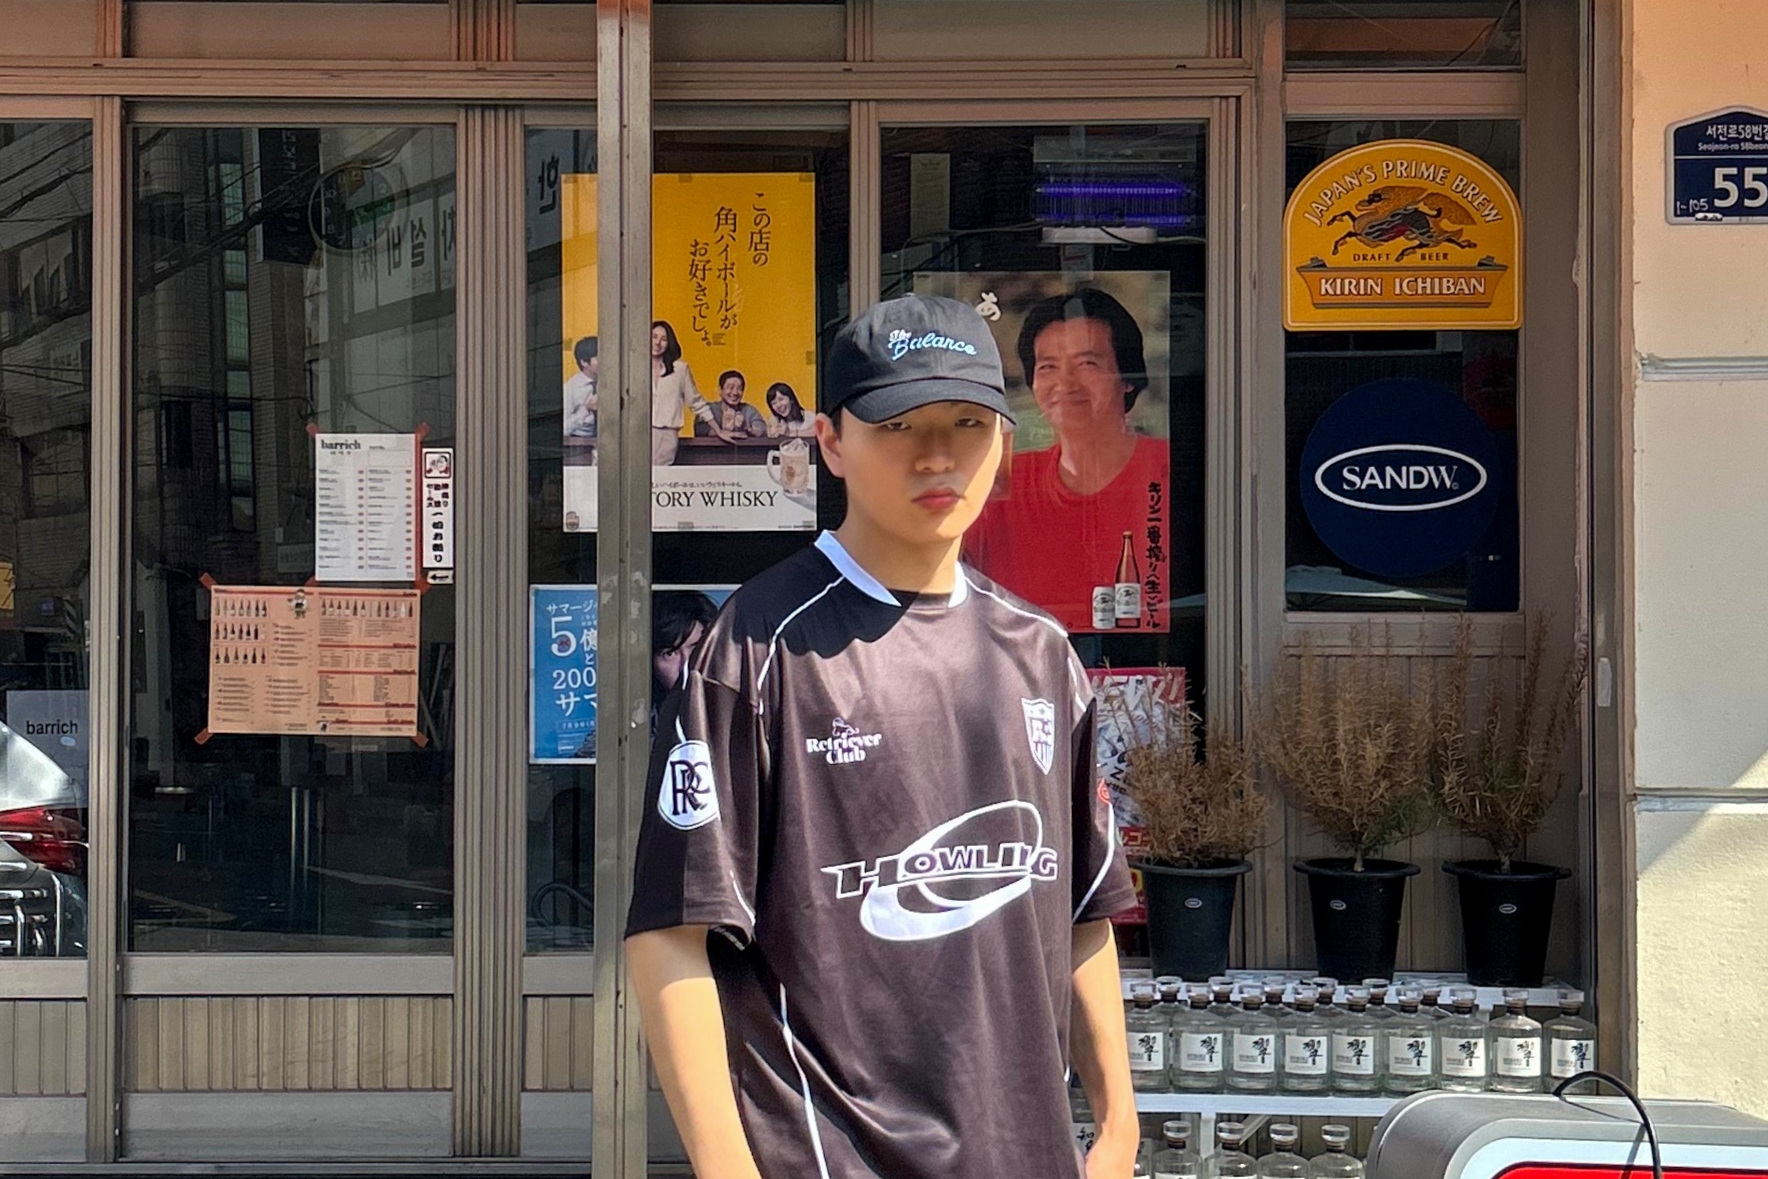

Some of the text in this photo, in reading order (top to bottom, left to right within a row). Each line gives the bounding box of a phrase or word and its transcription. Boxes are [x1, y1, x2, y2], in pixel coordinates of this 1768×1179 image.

[1303, 159, 1504, 227] JAPAN'S PRIME BREW
[1713, 166, 1768, 208] 55
[748, 192, 771, 267] この店の
[714, 205, 738, 330] 角ハイボールが
[1353, 252, 1449, 262] DRAFT BEER
[688, 238, 713, 347] お好きでしょ。
[1320, 277, 1486, 296] KIRIN ICHIBAN
[888, 332, 977, 361] Balance
[700, 490, 779, 508] WHISKY
[26, 720, 78, 735] barrich
[806, 732, 883, 753] Retriever
[826, 747, 867, 765] Club
